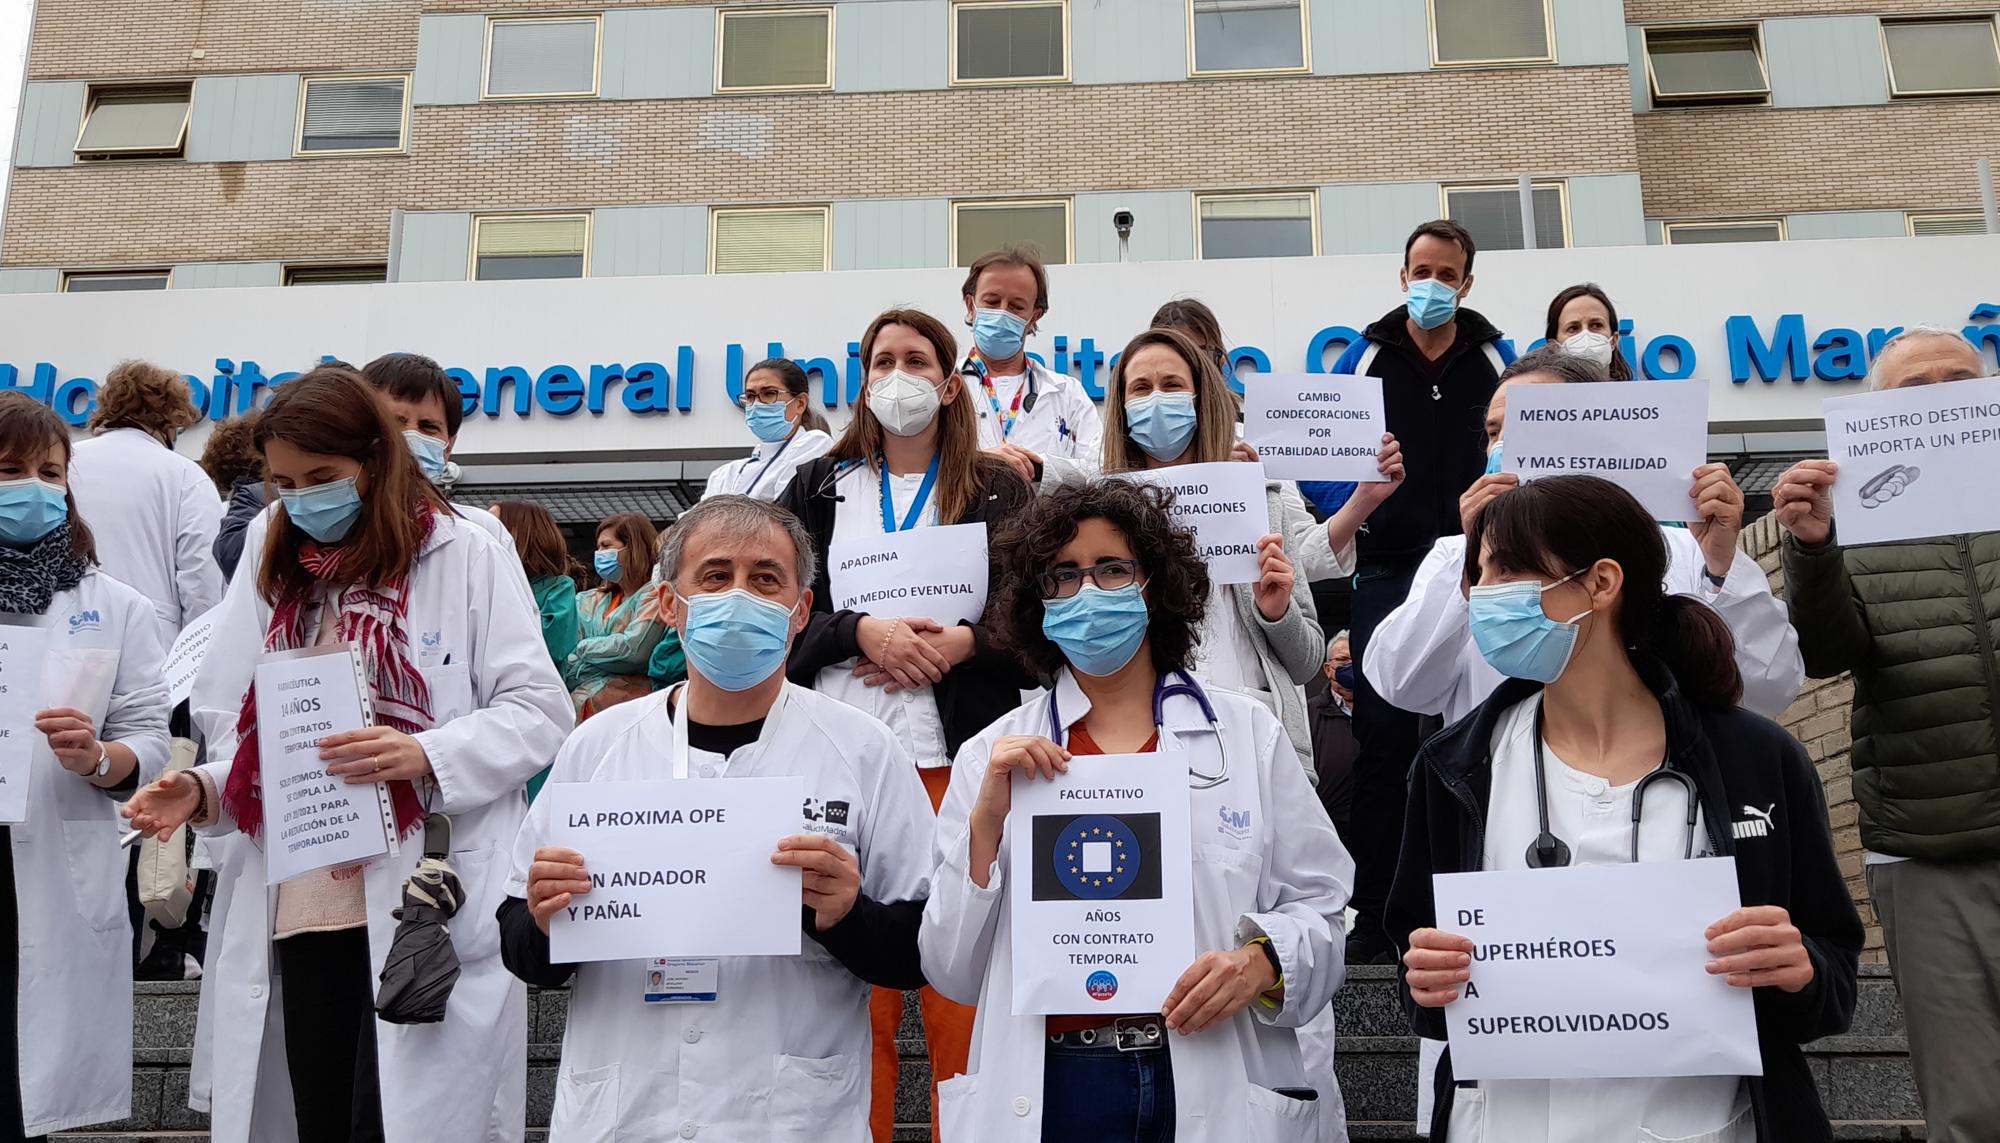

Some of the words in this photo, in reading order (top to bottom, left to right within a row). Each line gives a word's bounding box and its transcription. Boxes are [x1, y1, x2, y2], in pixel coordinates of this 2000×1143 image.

[0, 355, 336, 430] Hoit
[393, 345, 694, 417] eneral
[1297, 392, 1341, 402] CAMBIO
[1266, 409, 1370, 420] CONDECORACIONES
[1520, 409, 1577, 422] MENOS
[1581, 407, 1660, 421] APLAUSOS
[1845, 412, 1922, 434] NUESTRO
[1928, 403, 2000, 424] DESTINO
[1308, 428, 1331, 438] POR
[1848, 437, 1925, 457] IMPORTA
[1930, 433, 1955, 447] UN
[1961, 428, 2000, 444] PEPI
[1258, 446, 1328, 457] ESTABILIDAD
[1331, 447, 1378, 457] LABORAL
[1517, 456, 1526, 468] Y
[1530, 456, 1565, 469] MAS
[1570, 456, 1667, 470] ESTABILIDAD
[1164, 484, 1209, 497] AMBIO
[1200, 544, 1257, 557] LABORAL
[840, 552, 898, 571] APADRINA
[842, 596, 857, 609] UN
[860, 588, 907, 604] MEDICO
[911, 584, 974, 596] EVENTUAL
[174, 623, 211, 653] CAMBIO
[164, 632, 212, 673] NDECORA
[290, 697, 321, 715] AÑOS
[285, 738, 322, 754] TEMPORALE
[324, 783, 336, 793] LA
[1060, 788, 1144, 799] FACULTATIVO
[321, 798, 350, 811] PARA
[330, 815, 344, 826] DE
[347, 812, 359, 822] LA
[569, 813, 590, 828] LA
[596, 810, 684, 826] PROXIMA
[689, 808, 726, 823] OPE
[1732, 819, 1768, 839] UMA
[287, 830, 350, 854] TEMPORALIDAD
[610, 869, 706, 887] ANDADOR
[567, 906, 579, 921] Y
[584, 900, 642, 920] PAÑAL
[1085, 909, 1121, 922] AÑOS
[1458, 909, 1485, 926] DE
[1052, 934, 1080, 944] CON
[1084, 933, 1154, 944] CONTRATO
[1471, 937, 1616, 961] UPERHÉROES
[1069, 954, 1139, 964] TEMPORAL
[1464, 981, 1479, 999] A
[1467, 1012, 1670, 1035] SUPEROLVIDADOS
